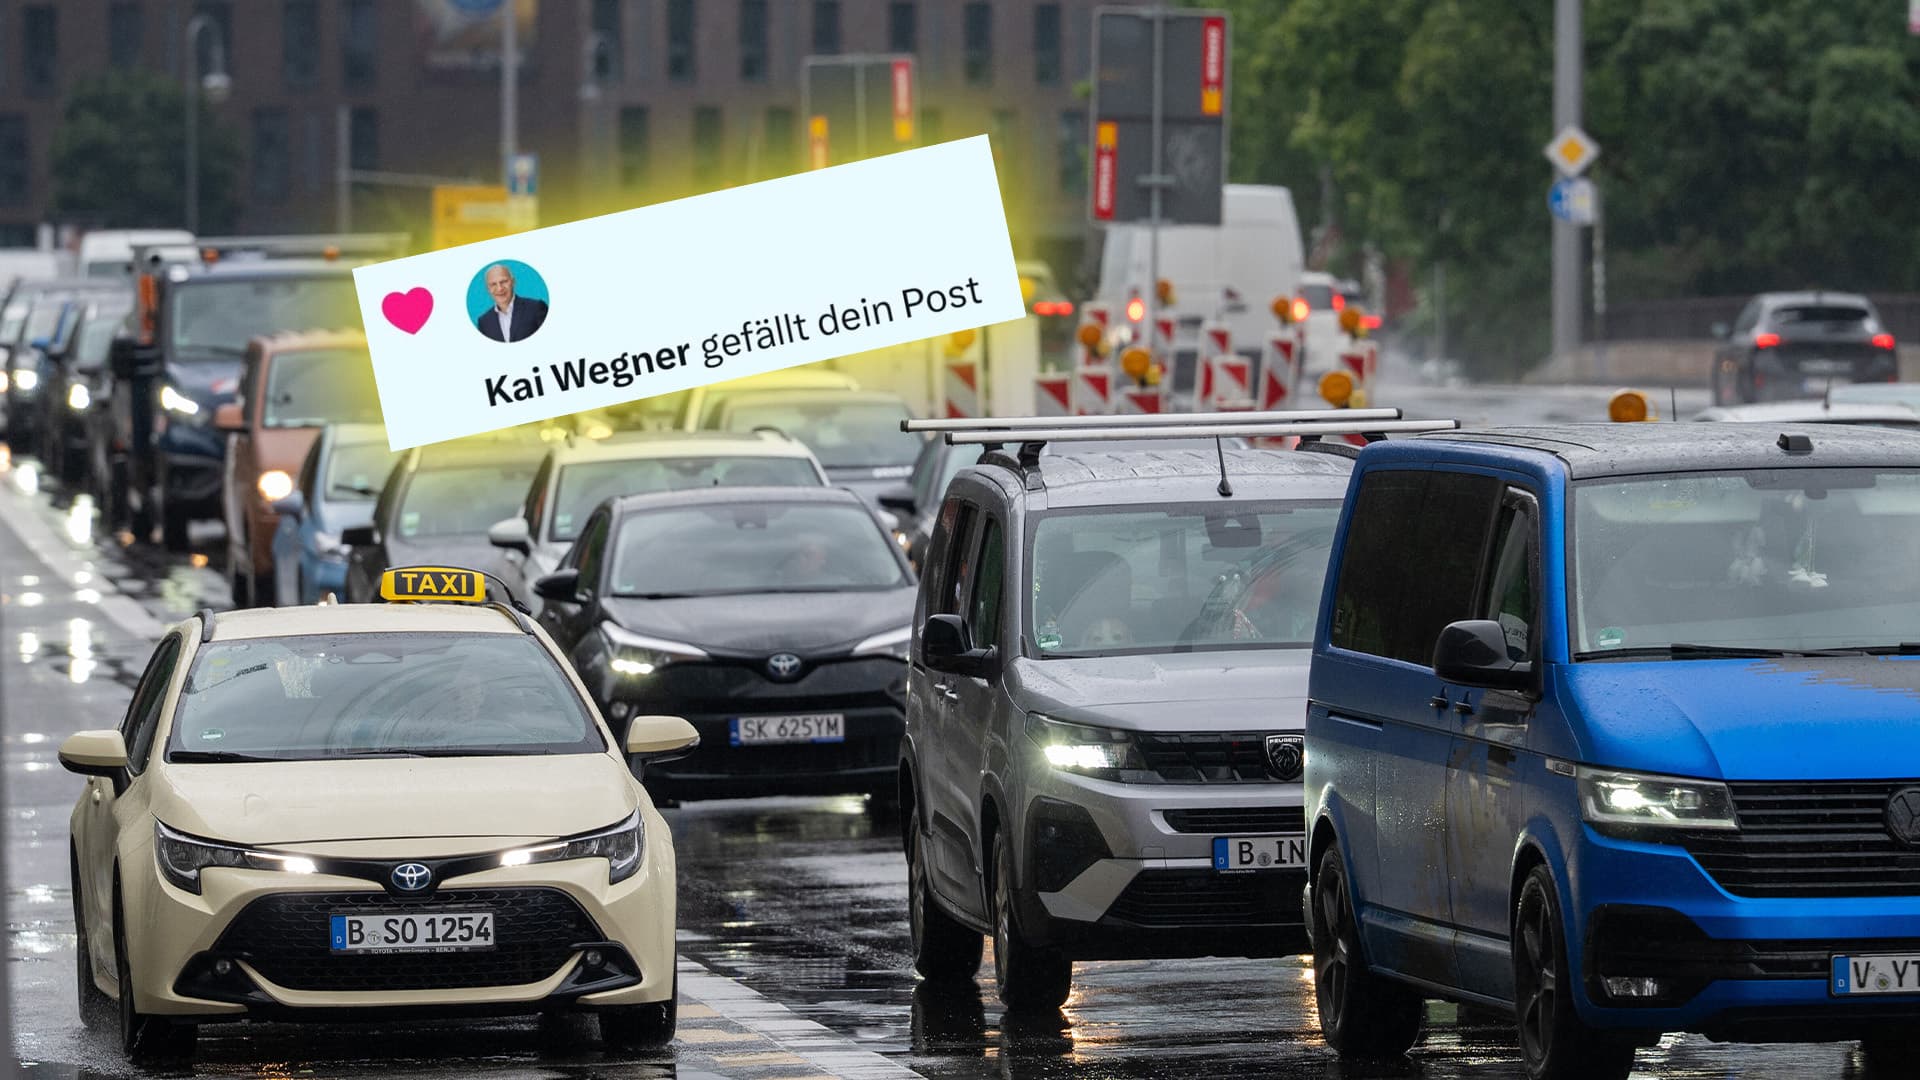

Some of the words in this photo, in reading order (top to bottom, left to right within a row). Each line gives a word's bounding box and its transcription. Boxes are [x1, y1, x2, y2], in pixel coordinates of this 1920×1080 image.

[401, 573, 467, 595] TAXI
[743, 719, 769, 739] SK
[777, 717, 839, 738] 625YM
[1238, 841, 1255, 865] B
[1274, 839, 1305, 865] IN
[348, 919, 365, 945] B
[383, 917, 418, 944] SO
[425, 916, 491, 943] 1254
[1853, 961, 1871, 989] V
